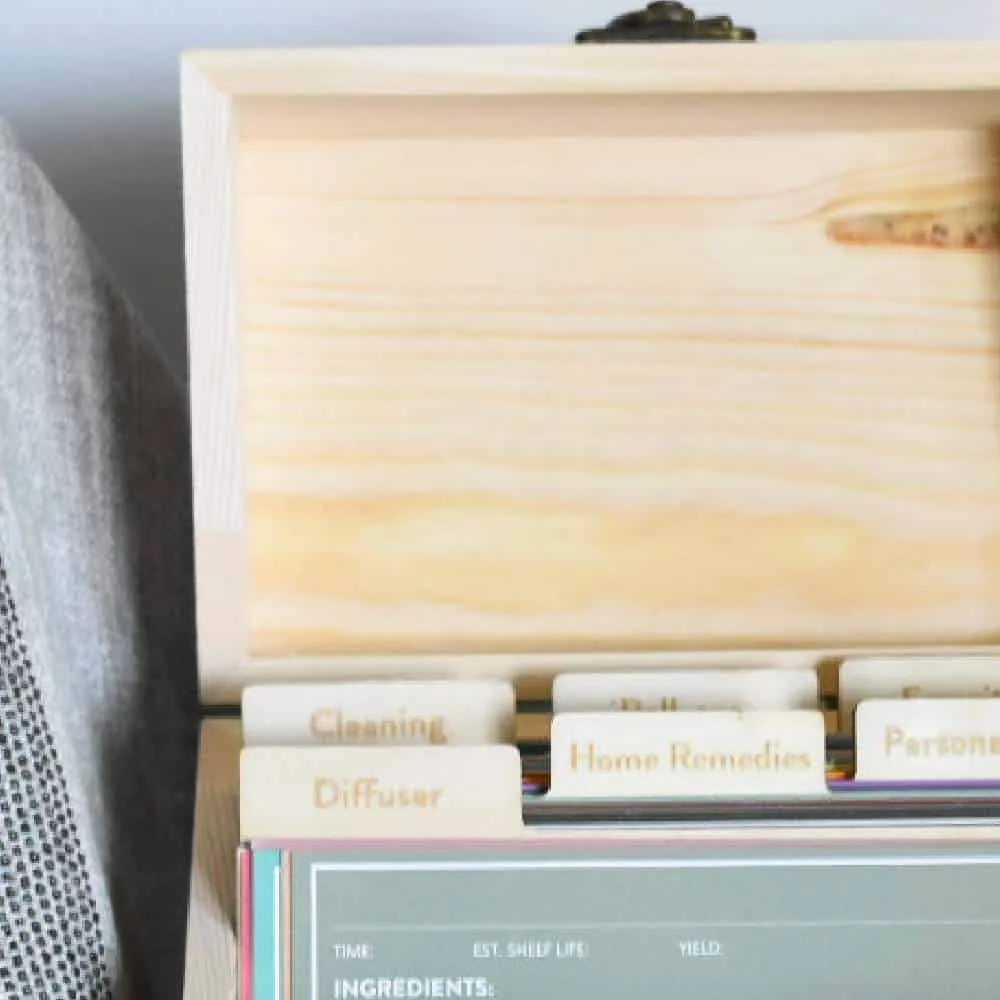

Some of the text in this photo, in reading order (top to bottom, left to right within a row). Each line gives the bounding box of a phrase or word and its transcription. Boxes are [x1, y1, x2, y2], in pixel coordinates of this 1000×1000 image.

[309, 706, 447, 745] Cleaning
[569, 740, 813, 772] Home Remedies
[313, 776, 443, 809] Diffuser
[333, 977, 495, 1000] INGREDIENTS:
